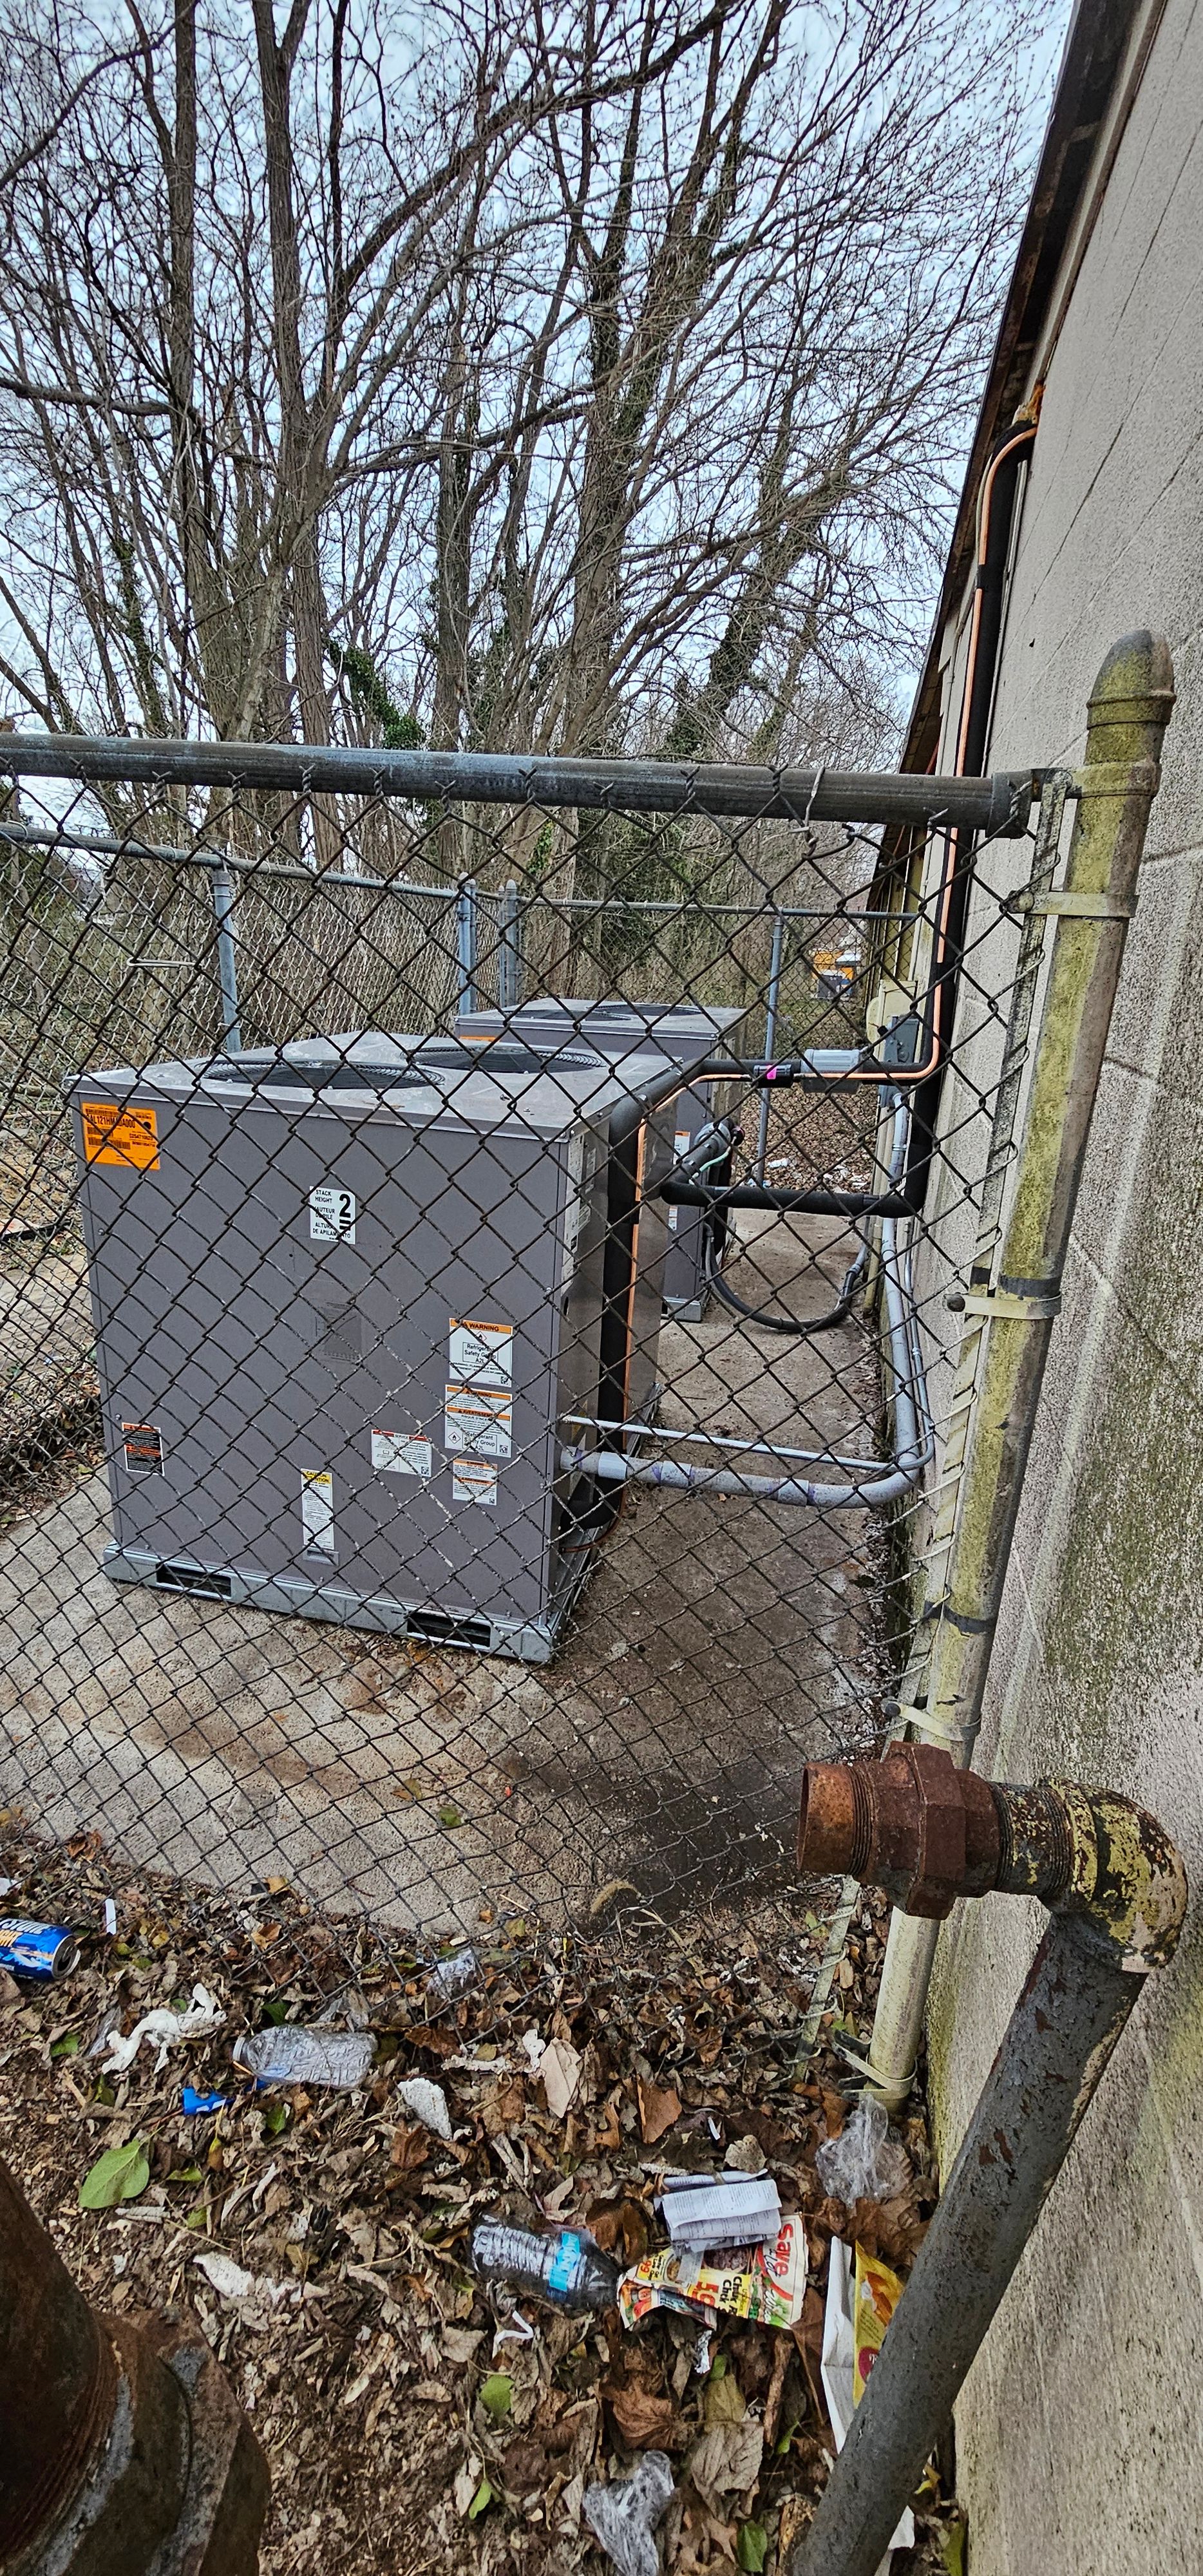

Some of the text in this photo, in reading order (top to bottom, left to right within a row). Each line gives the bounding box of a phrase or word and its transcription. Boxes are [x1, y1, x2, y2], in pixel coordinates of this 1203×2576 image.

[339, 1193, 351, 1218] 2
[469, 1323, 499, 1332] WARNING
[467, 1343, 495, 1352] Refriger
[466, 1431, 493, 1441] Refrgerant
[775, 2223, 793, 2276] Save
